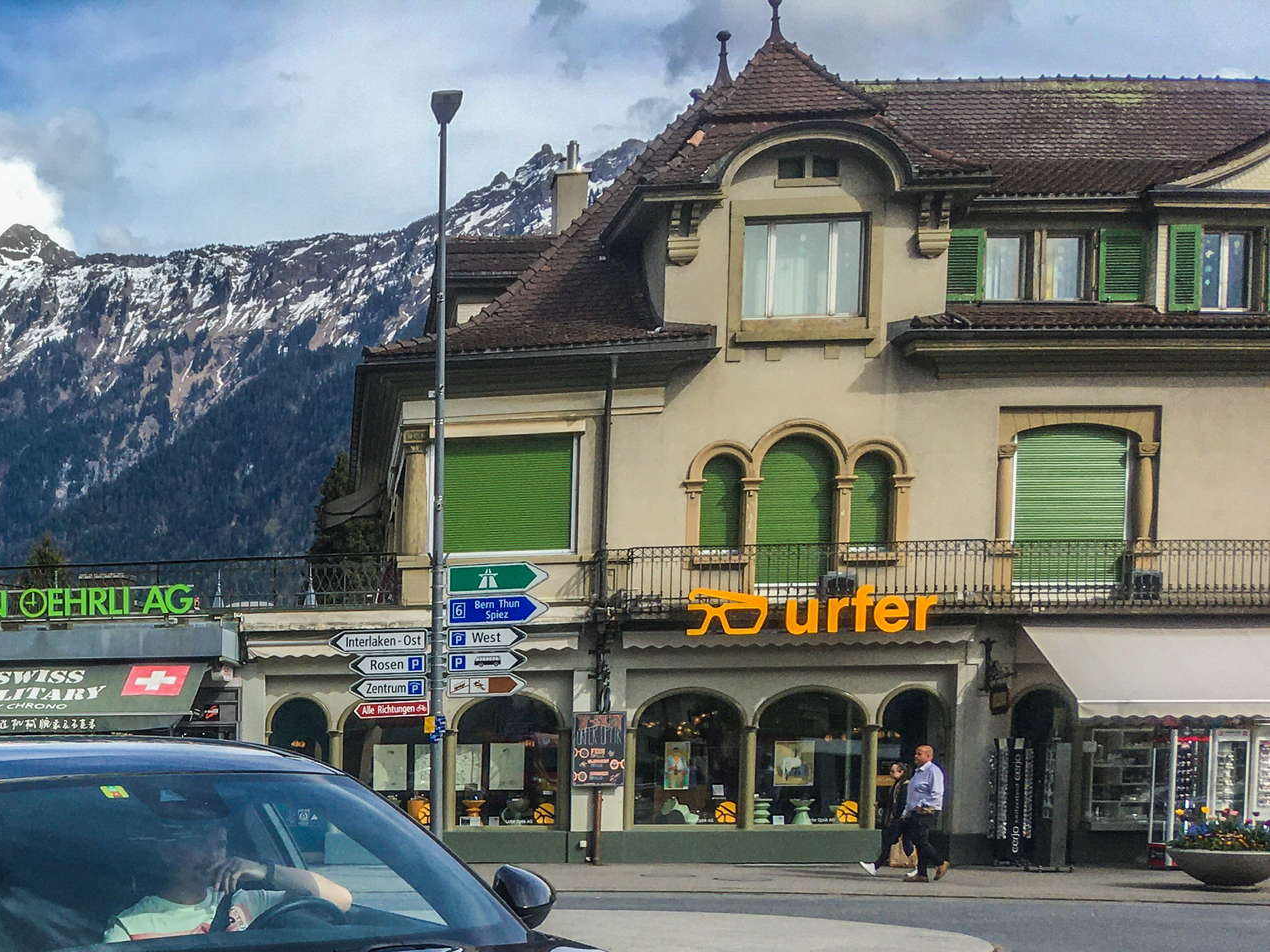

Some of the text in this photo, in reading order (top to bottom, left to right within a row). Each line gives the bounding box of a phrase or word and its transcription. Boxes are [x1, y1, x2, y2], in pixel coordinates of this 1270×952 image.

[19, 586, 130, 619] OEHRLI
[142, 583, 195, 615] AG
[455, 599, 520, 617] 6 Bern Thun
[784, 584, 938, 635] urfer
[485, 610, 509, 621] Spiez
[472, 631, 501, 643] West
[370, 659, 404, 671] Rosen
[366, 682, 407, 695] Zentrum
[6, 701, 68, 711] CHRONO
[361, 703, 416, 716] Alle Richtungen
